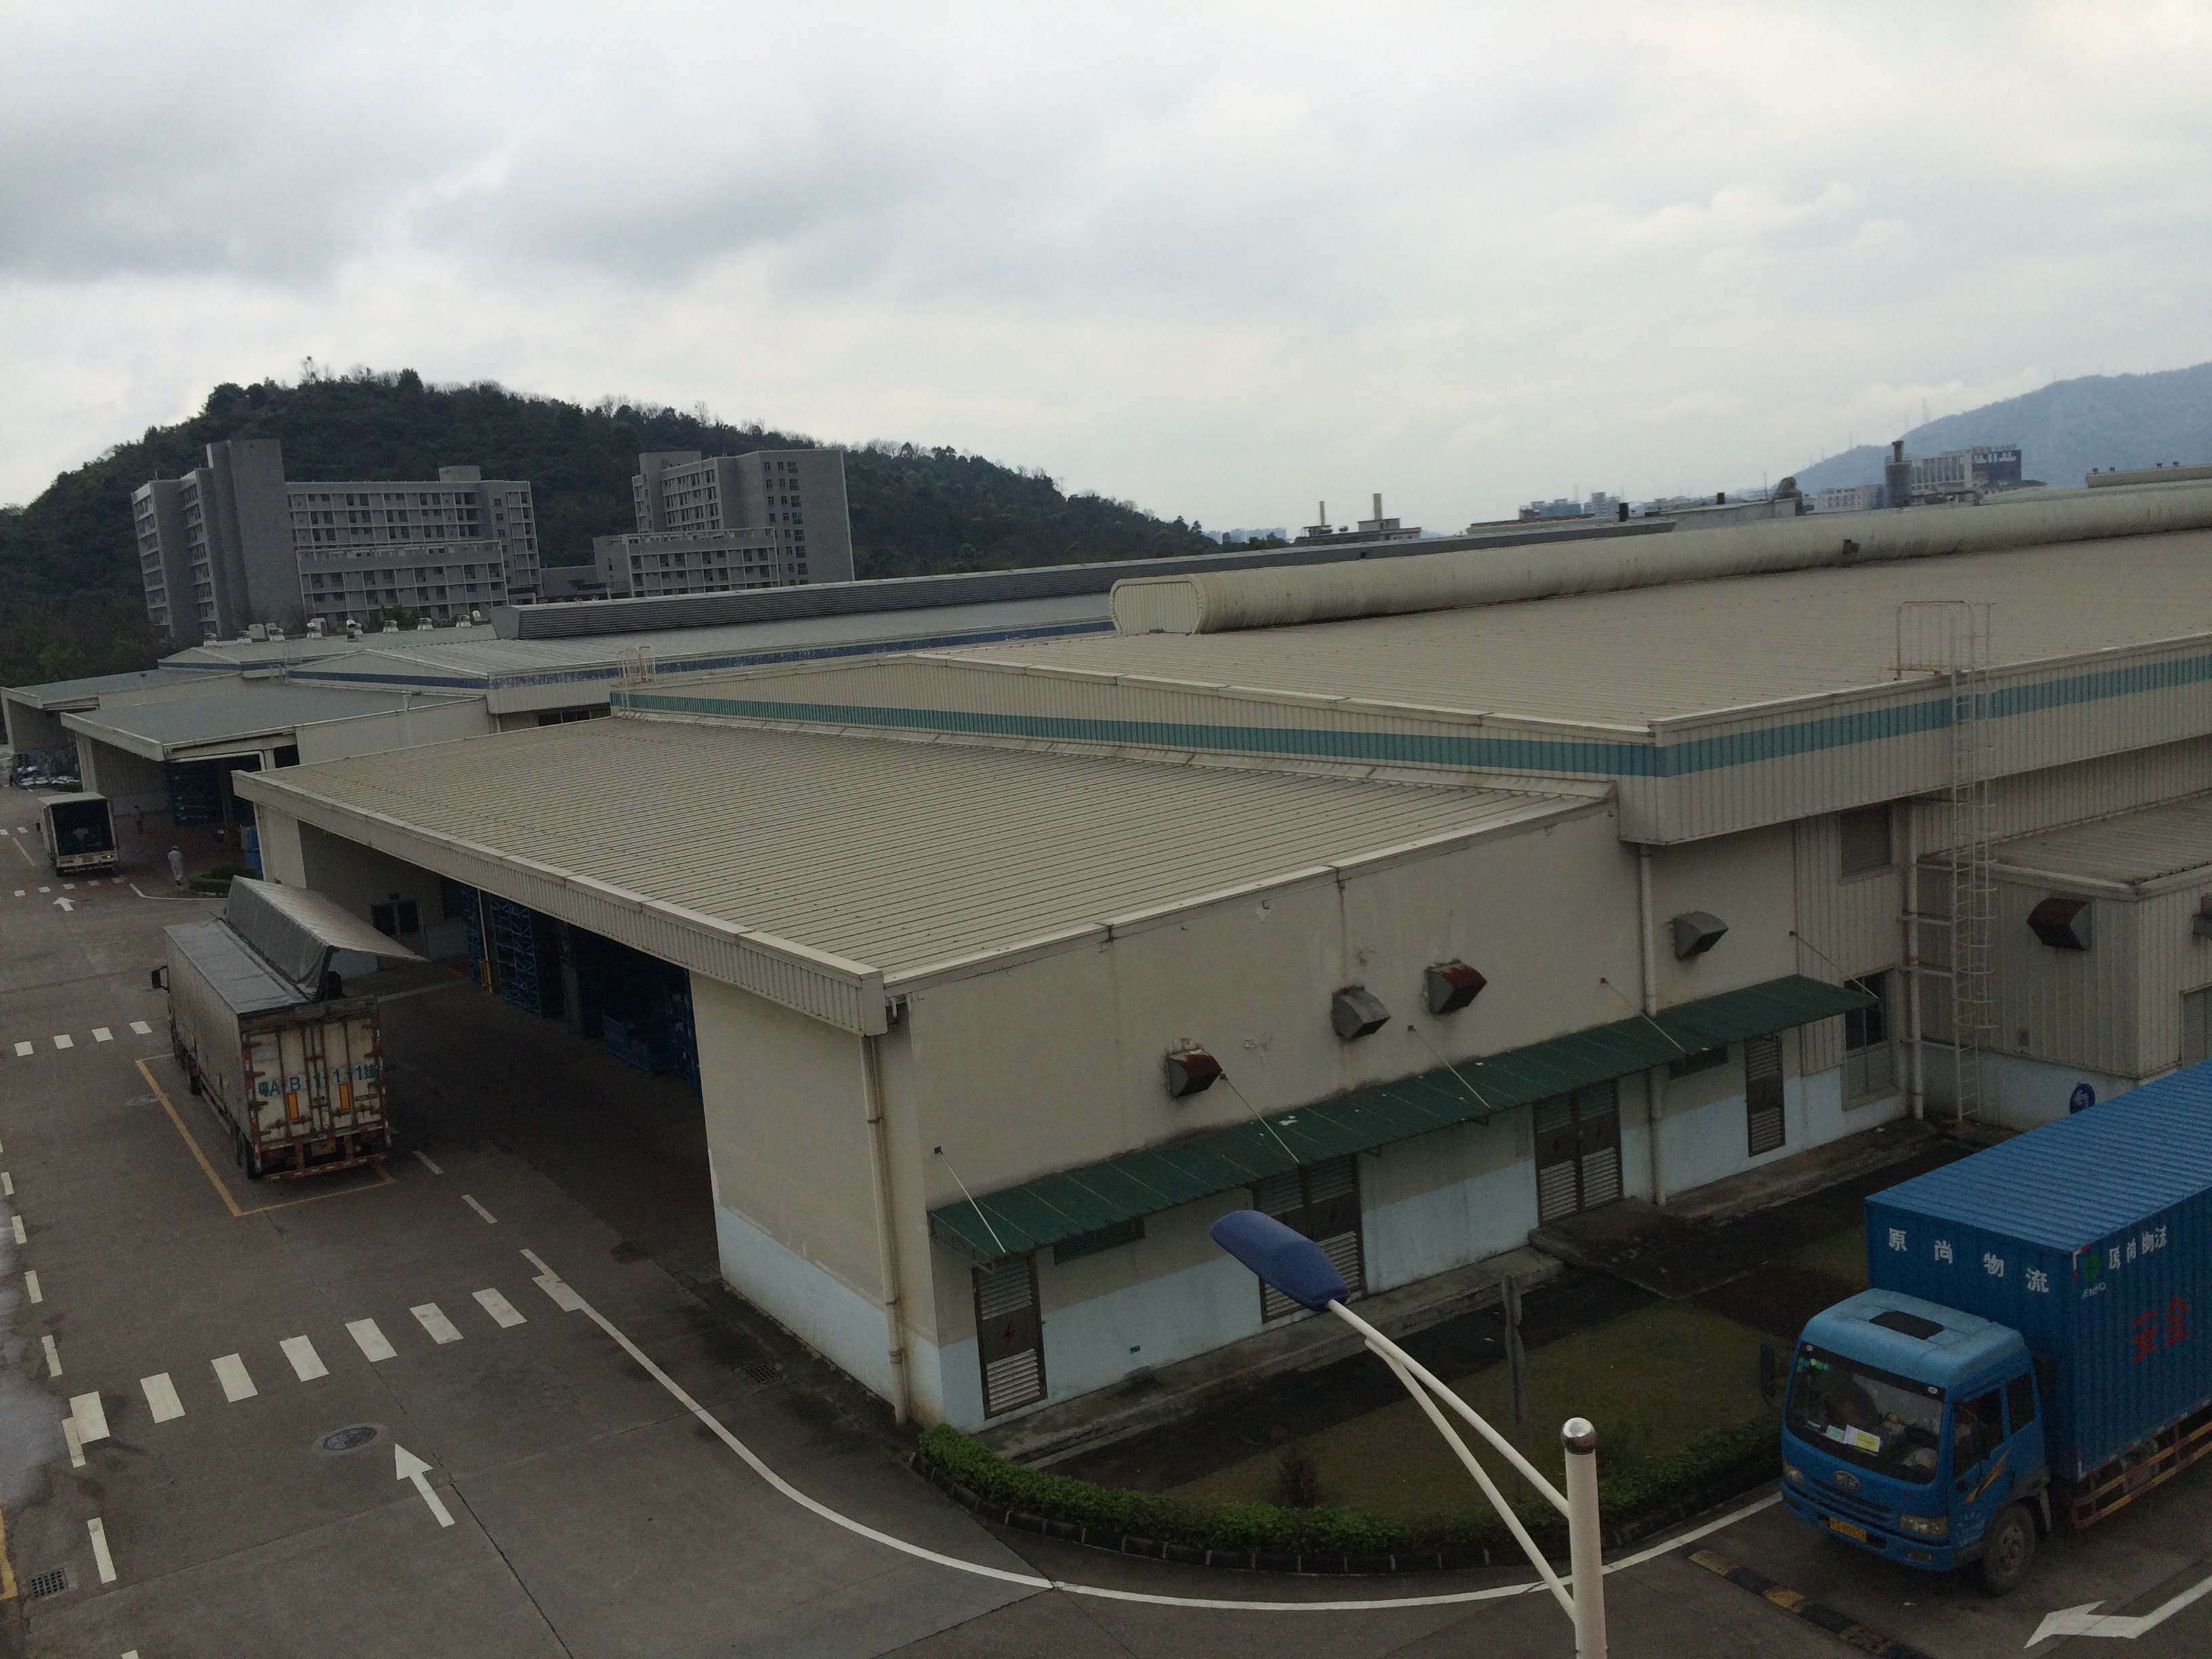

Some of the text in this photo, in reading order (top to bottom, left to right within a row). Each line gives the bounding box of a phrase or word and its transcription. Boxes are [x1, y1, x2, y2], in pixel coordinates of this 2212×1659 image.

[1889, 1227, 2049, 1292] 原尚物流
[2131, 1292, 2190, 1364] 安全
